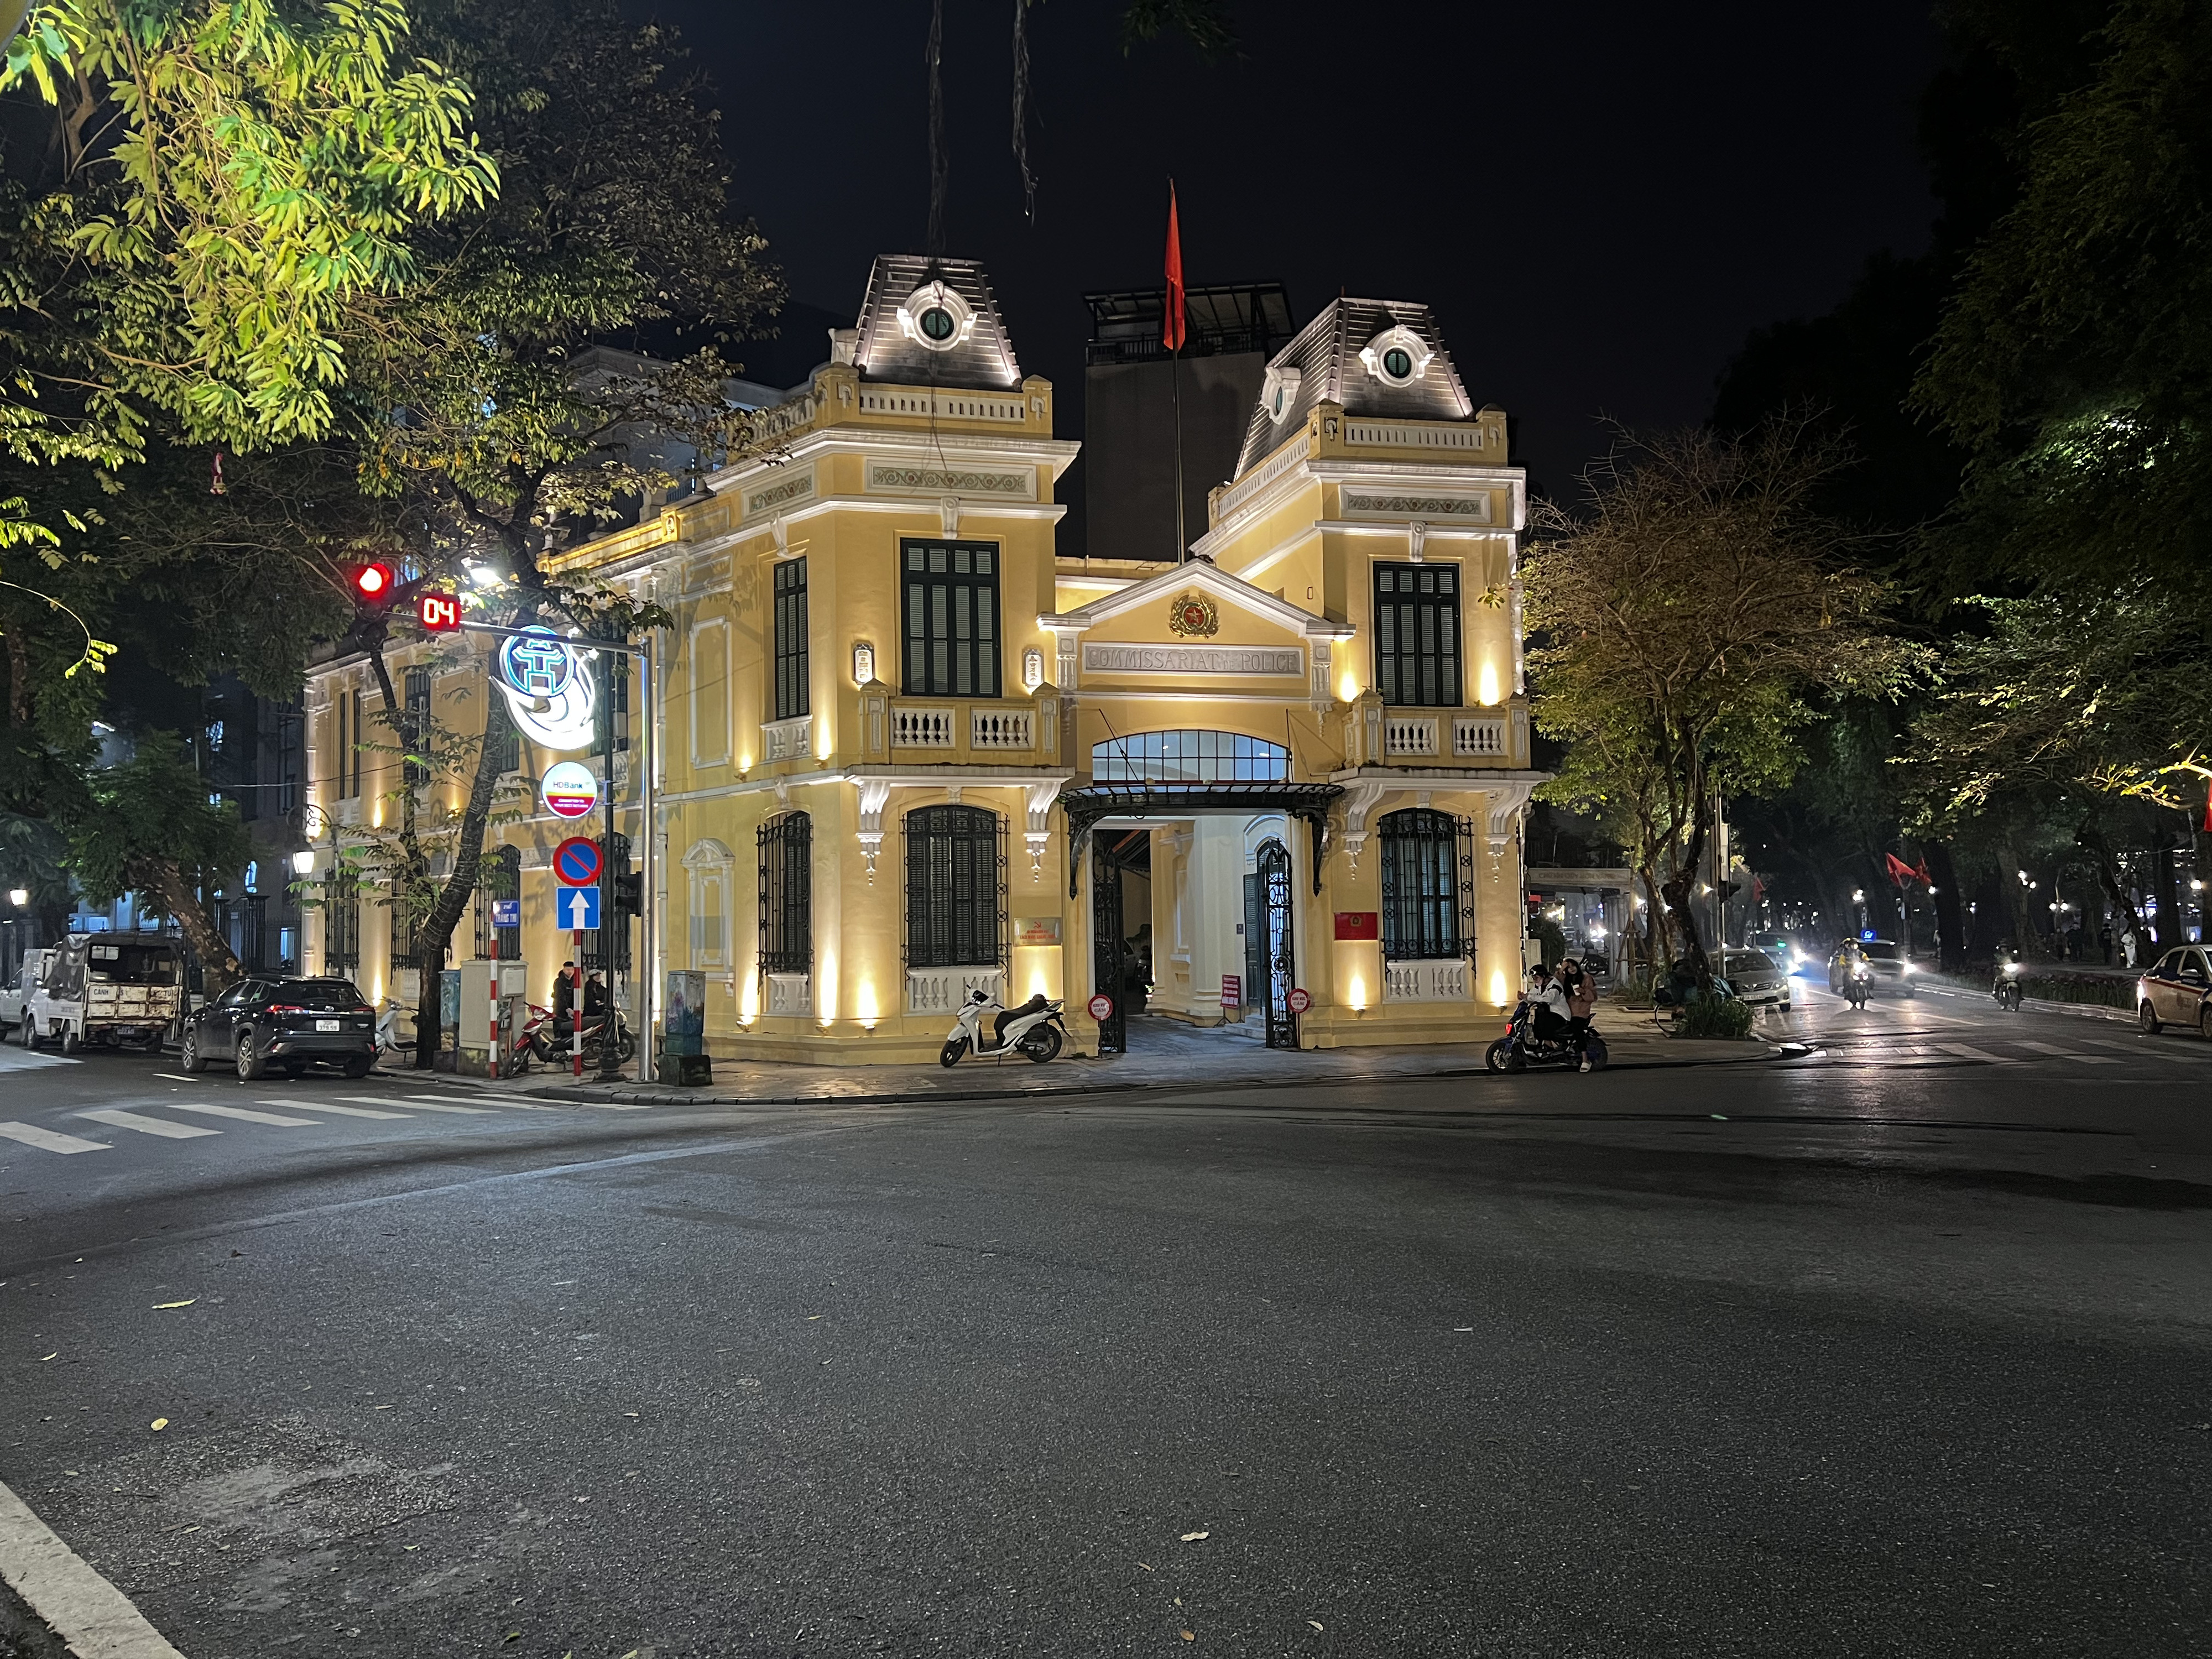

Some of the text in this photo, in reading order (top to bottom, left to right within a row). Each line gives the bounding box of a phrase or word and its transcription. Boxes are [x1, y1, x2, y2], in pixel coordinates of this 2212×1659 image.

[424, 598, 455, 625] 04
[1088, 649, 1219, 670] COMMISSARIAT
[1241, 653, 1297, 671] POLICE
